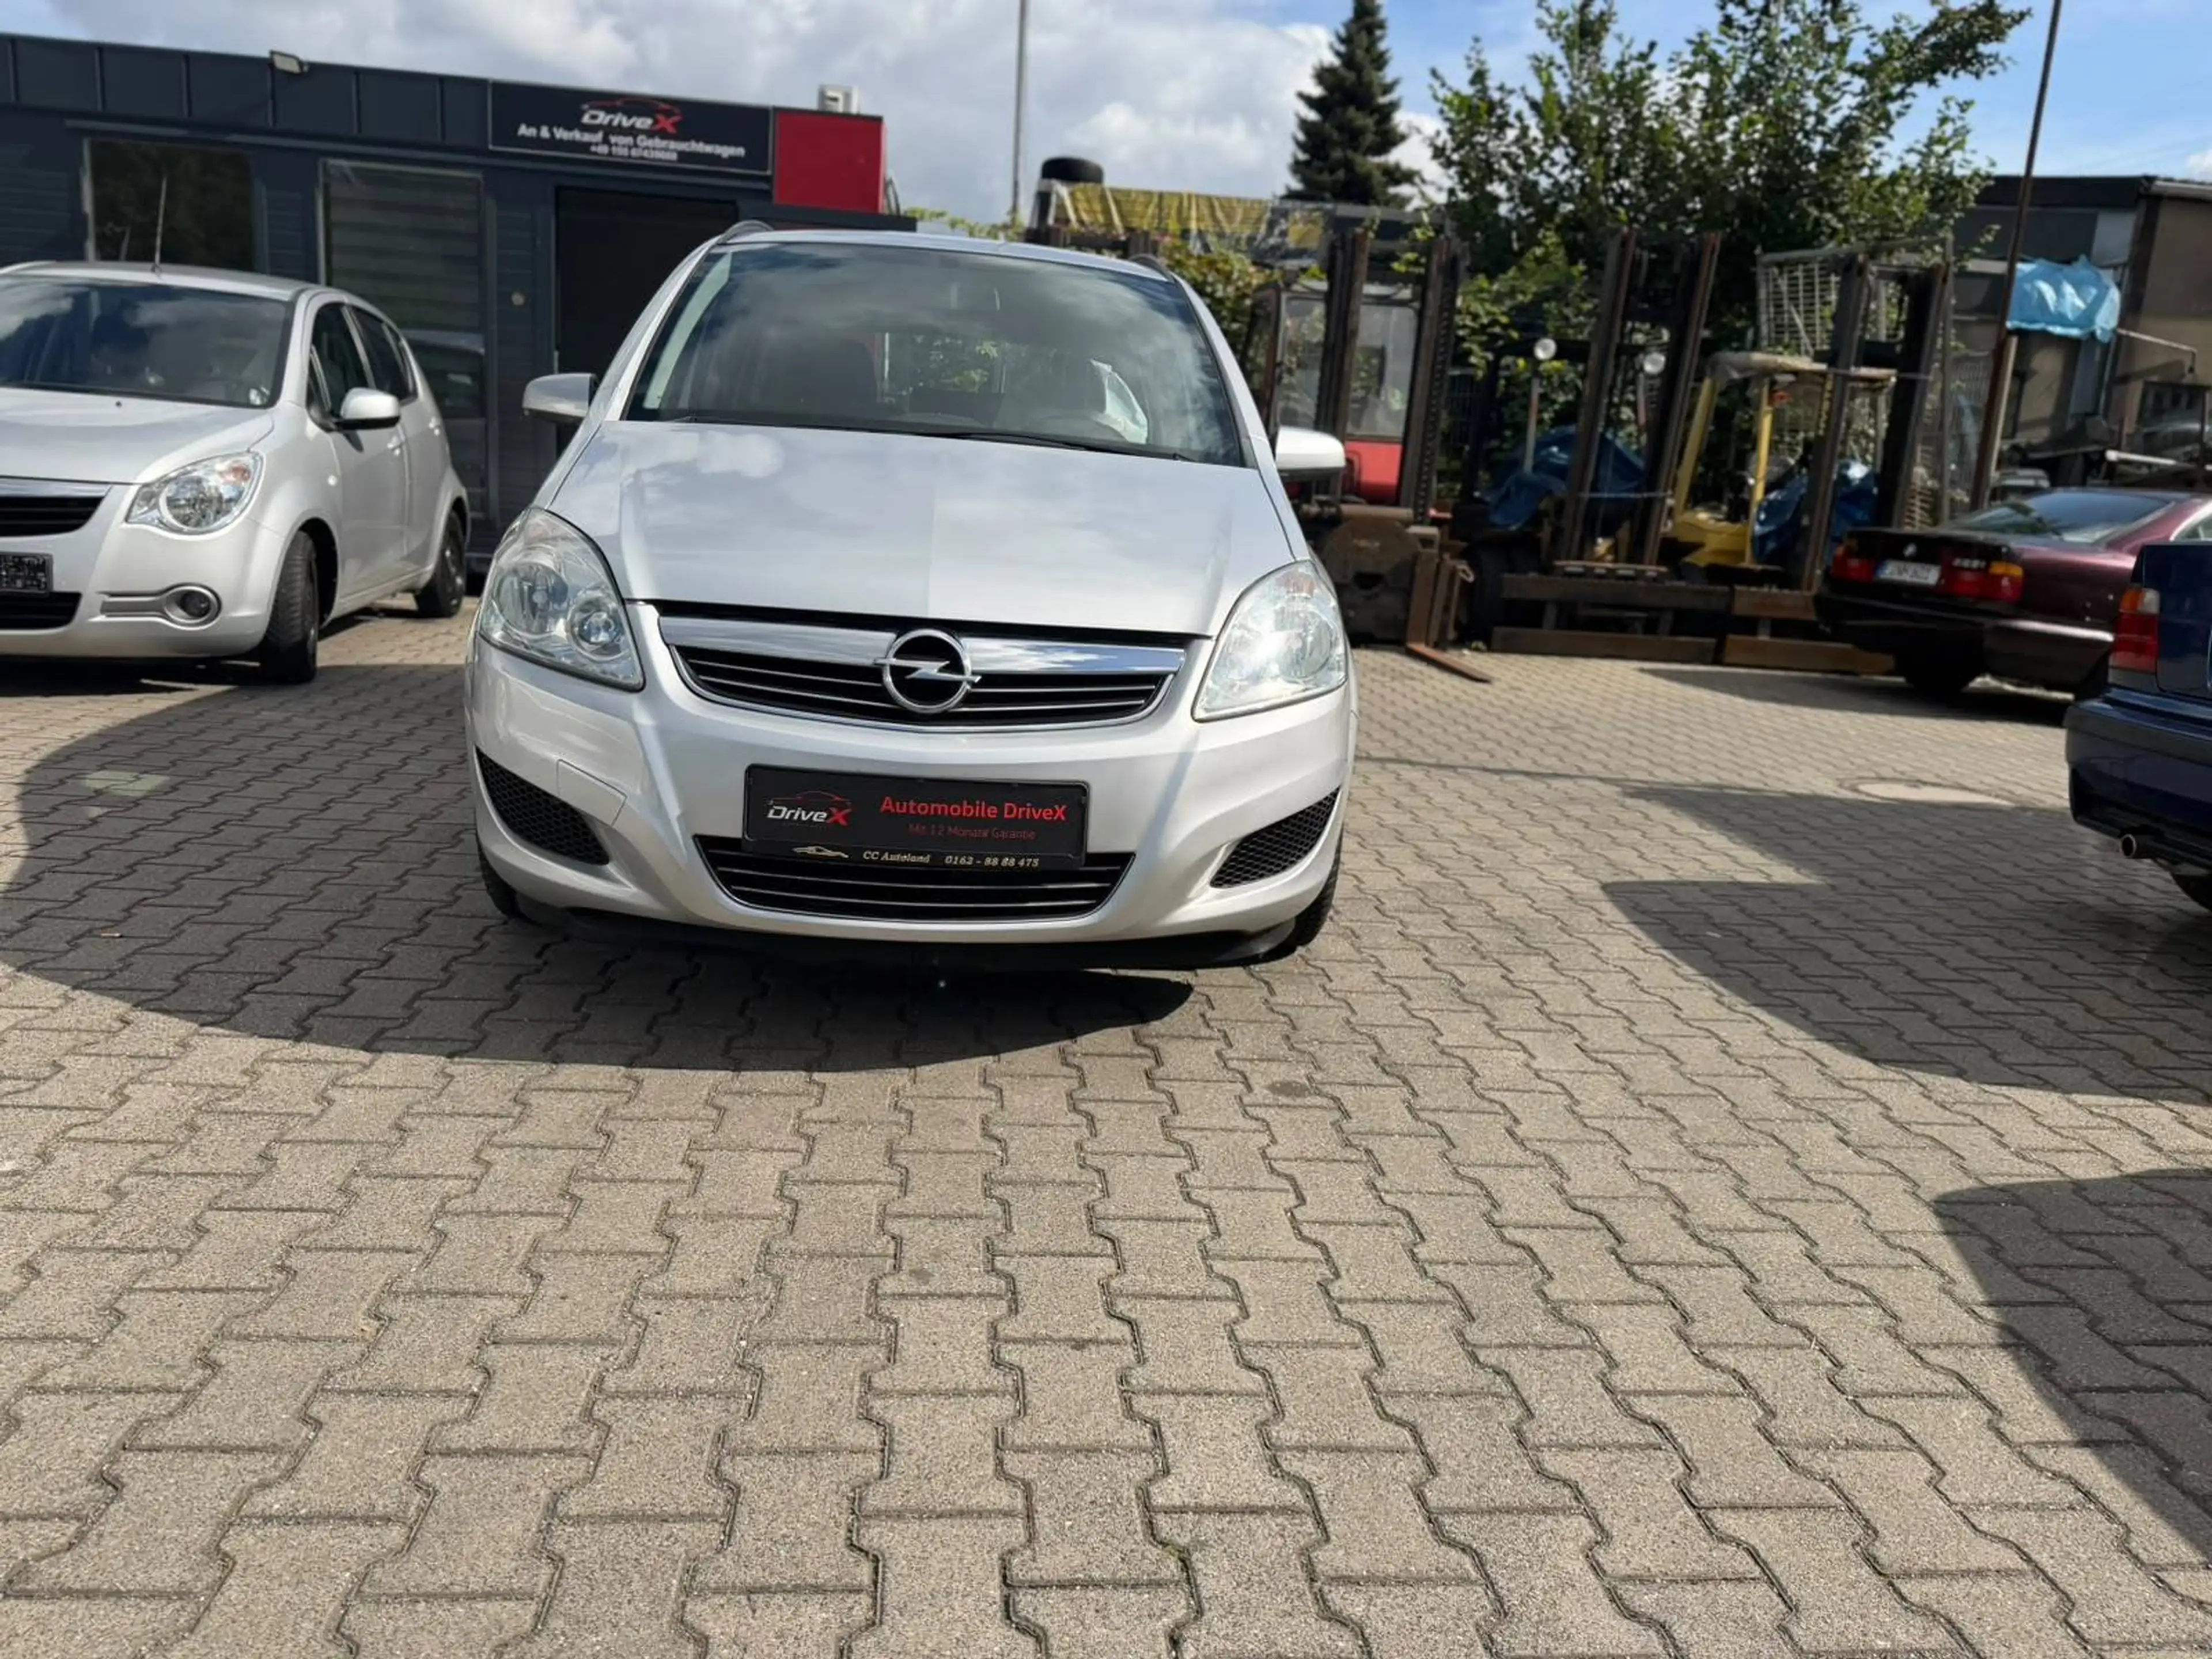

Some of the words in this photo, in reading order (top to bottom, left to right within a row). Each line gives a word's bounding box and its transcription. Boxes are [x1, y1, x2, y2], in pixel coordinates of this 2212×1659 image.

[582, 111, 682, 133] DriveX
[518, 123, 537, 137] An
[540, 126, 551, 139] &
[553, 127, 604, 143] Verkauf
[637, 135, 745, 157] Gebrauchtwagen
[767, 805, 853, 826] DriveX
[881, 797, 998, 818] Automobile
[1003, 803, 1068, 821] DriveX
[930, 825, 944, 836] 12
[992, 828, 1037, 841] Garantie
[863, 851, 879, 860] CC
[881, 851, 931, 863] Autoland
[1018, 858, 1040, 868] 475
